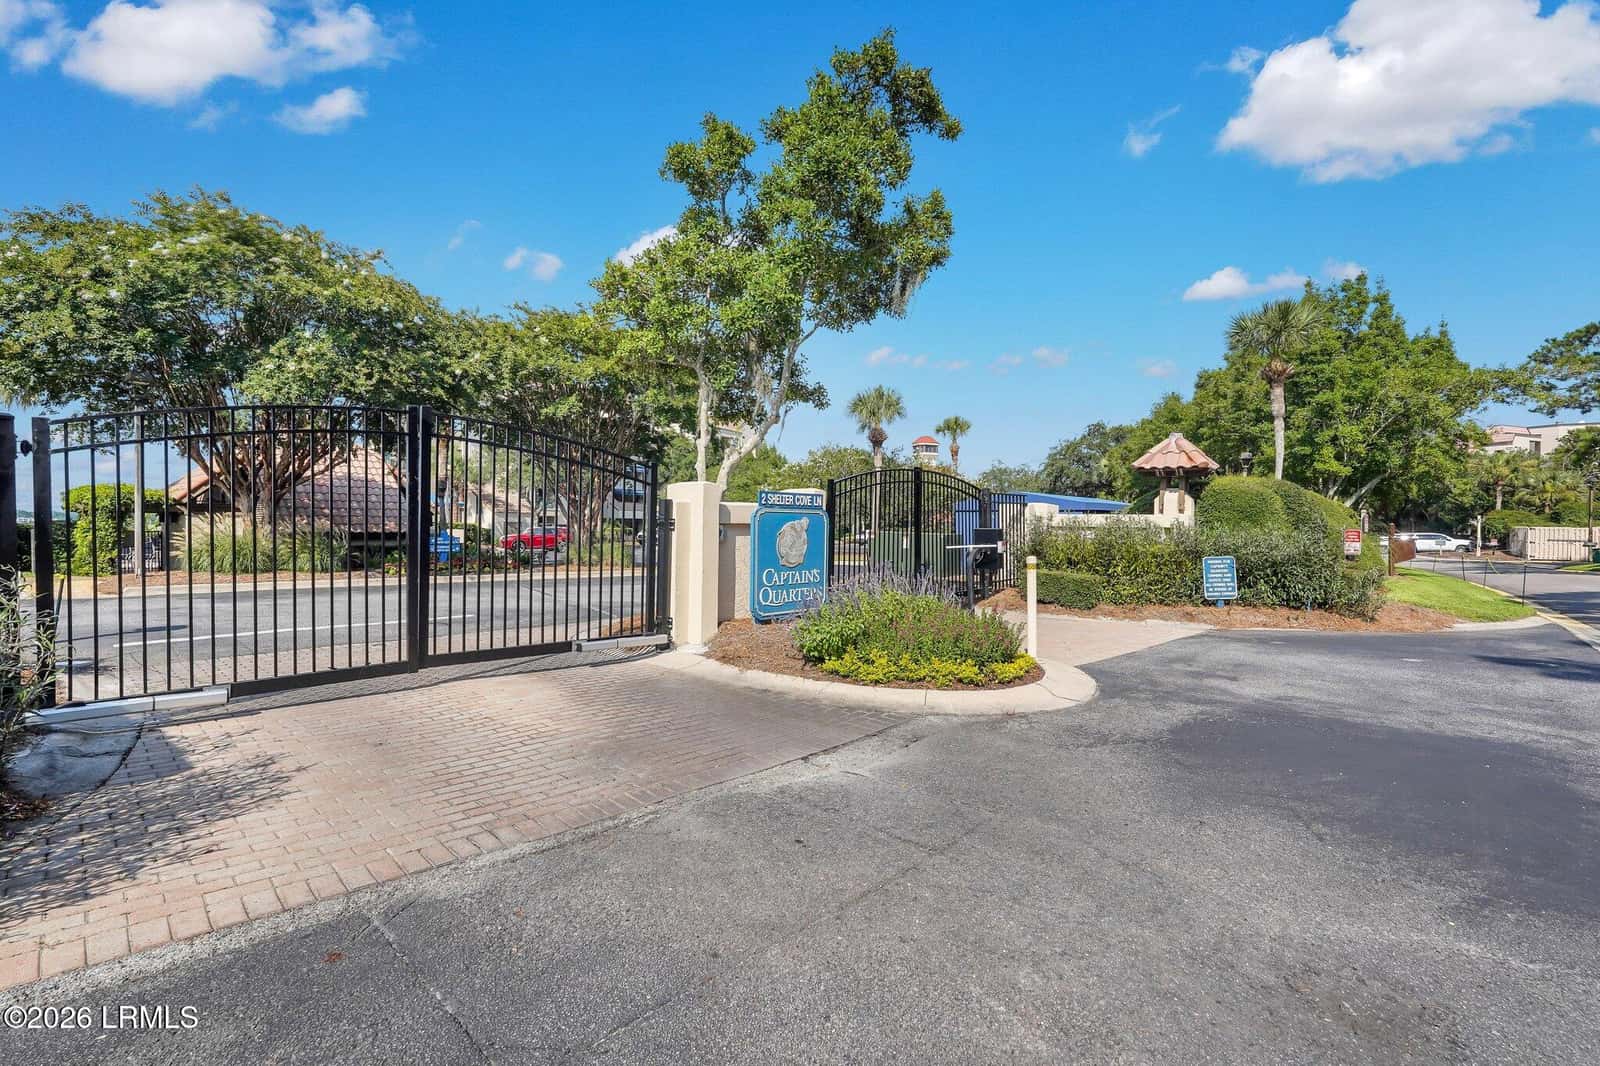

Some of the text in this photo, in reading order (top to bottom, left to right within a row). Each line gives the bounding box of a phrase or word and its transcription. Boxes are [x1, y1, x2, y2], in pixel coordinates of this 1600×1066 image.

[761, 493, 822, 506] 2 SHELTER COVE LN
